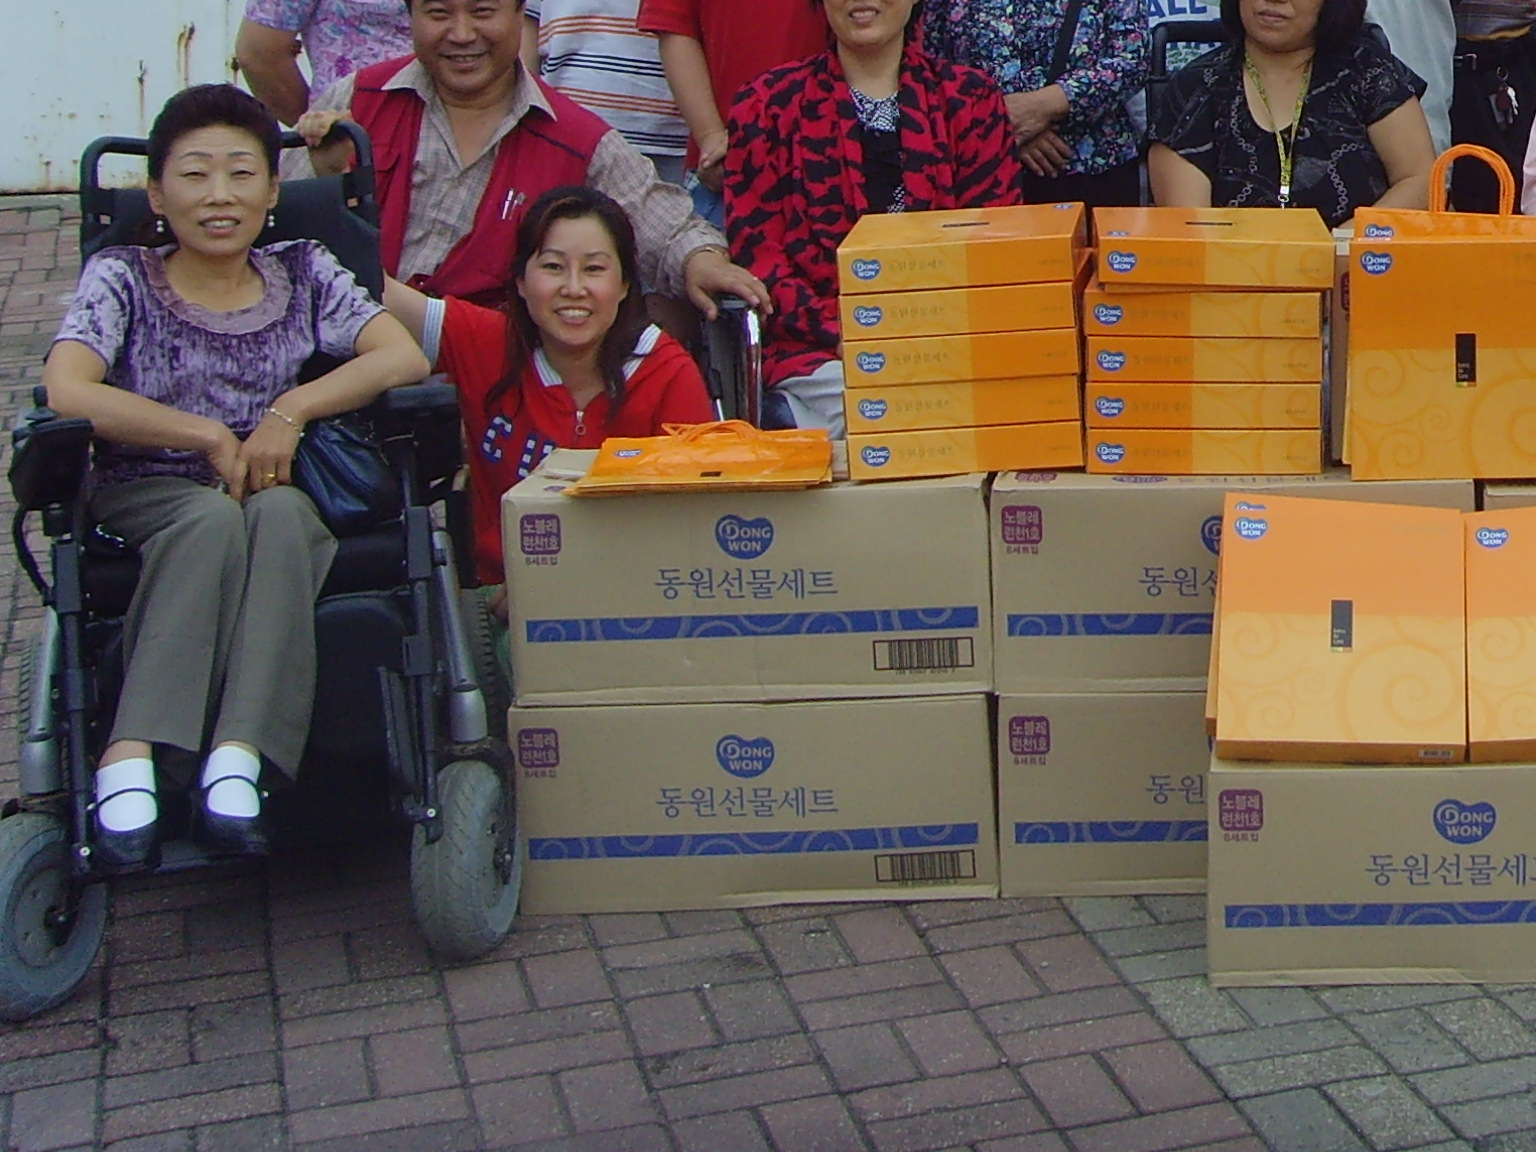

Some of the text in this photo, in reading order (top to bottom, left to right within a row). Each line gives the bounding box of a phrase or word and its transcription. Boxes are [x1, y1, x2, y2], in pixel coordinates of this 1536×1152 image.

[1362, 254, 1390, 264] DONG
[1004, 510, 1040, 524] 노블레
[523, 519, 558, 534] 노블레
[719, 520, 771, 540] DONG
[1237, 520, 1266, 529] DONG
[1004, 526, 1040, 541] 런천1호
[1478, 530, 1507, 538] DONG
[728, 541, 761, 551] WON
[655, 568, 838, 599] 동원선물세트
[1013, 721, 1046, 735] 노블레
[719, 740, 771, 758] DONG
[729, 760, 762, 770] WON
[656, 787, 839, 818] 동원선물세트
[1222, 796, 1260, 809] 노블레
[1222, 811, 1260, 827] 런천1호
[1437, 802, 1493, 826] DONG
[1446, 826, 1482, 837] WON
